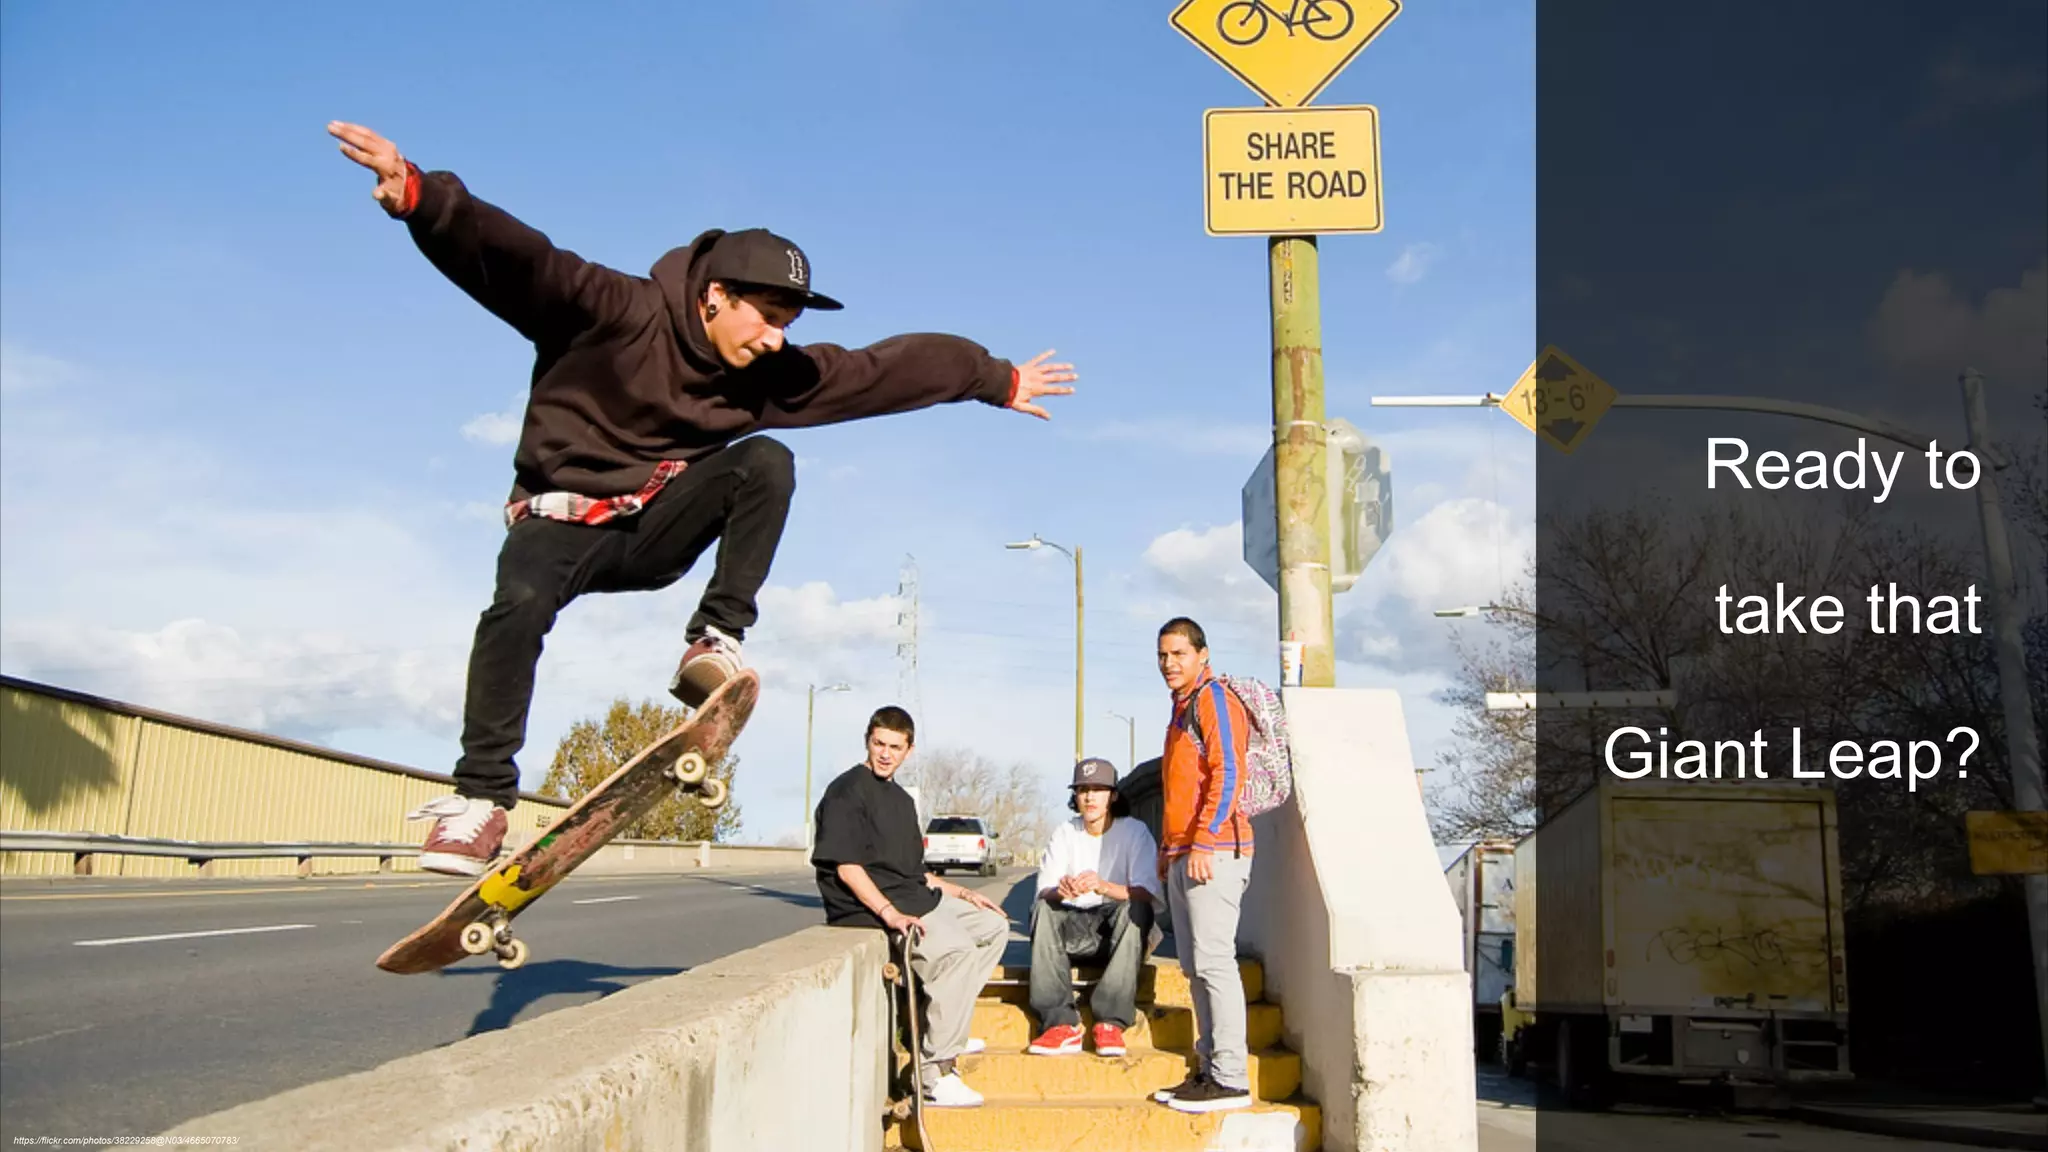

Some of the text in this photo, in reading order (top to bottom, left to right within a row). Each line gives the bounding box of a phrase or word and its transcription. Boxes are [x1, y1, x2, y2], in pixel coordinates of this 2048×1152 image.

[1247, 131, 1336, 161] SHARE
[1218, 170, 1367, 200] THE ROAD
